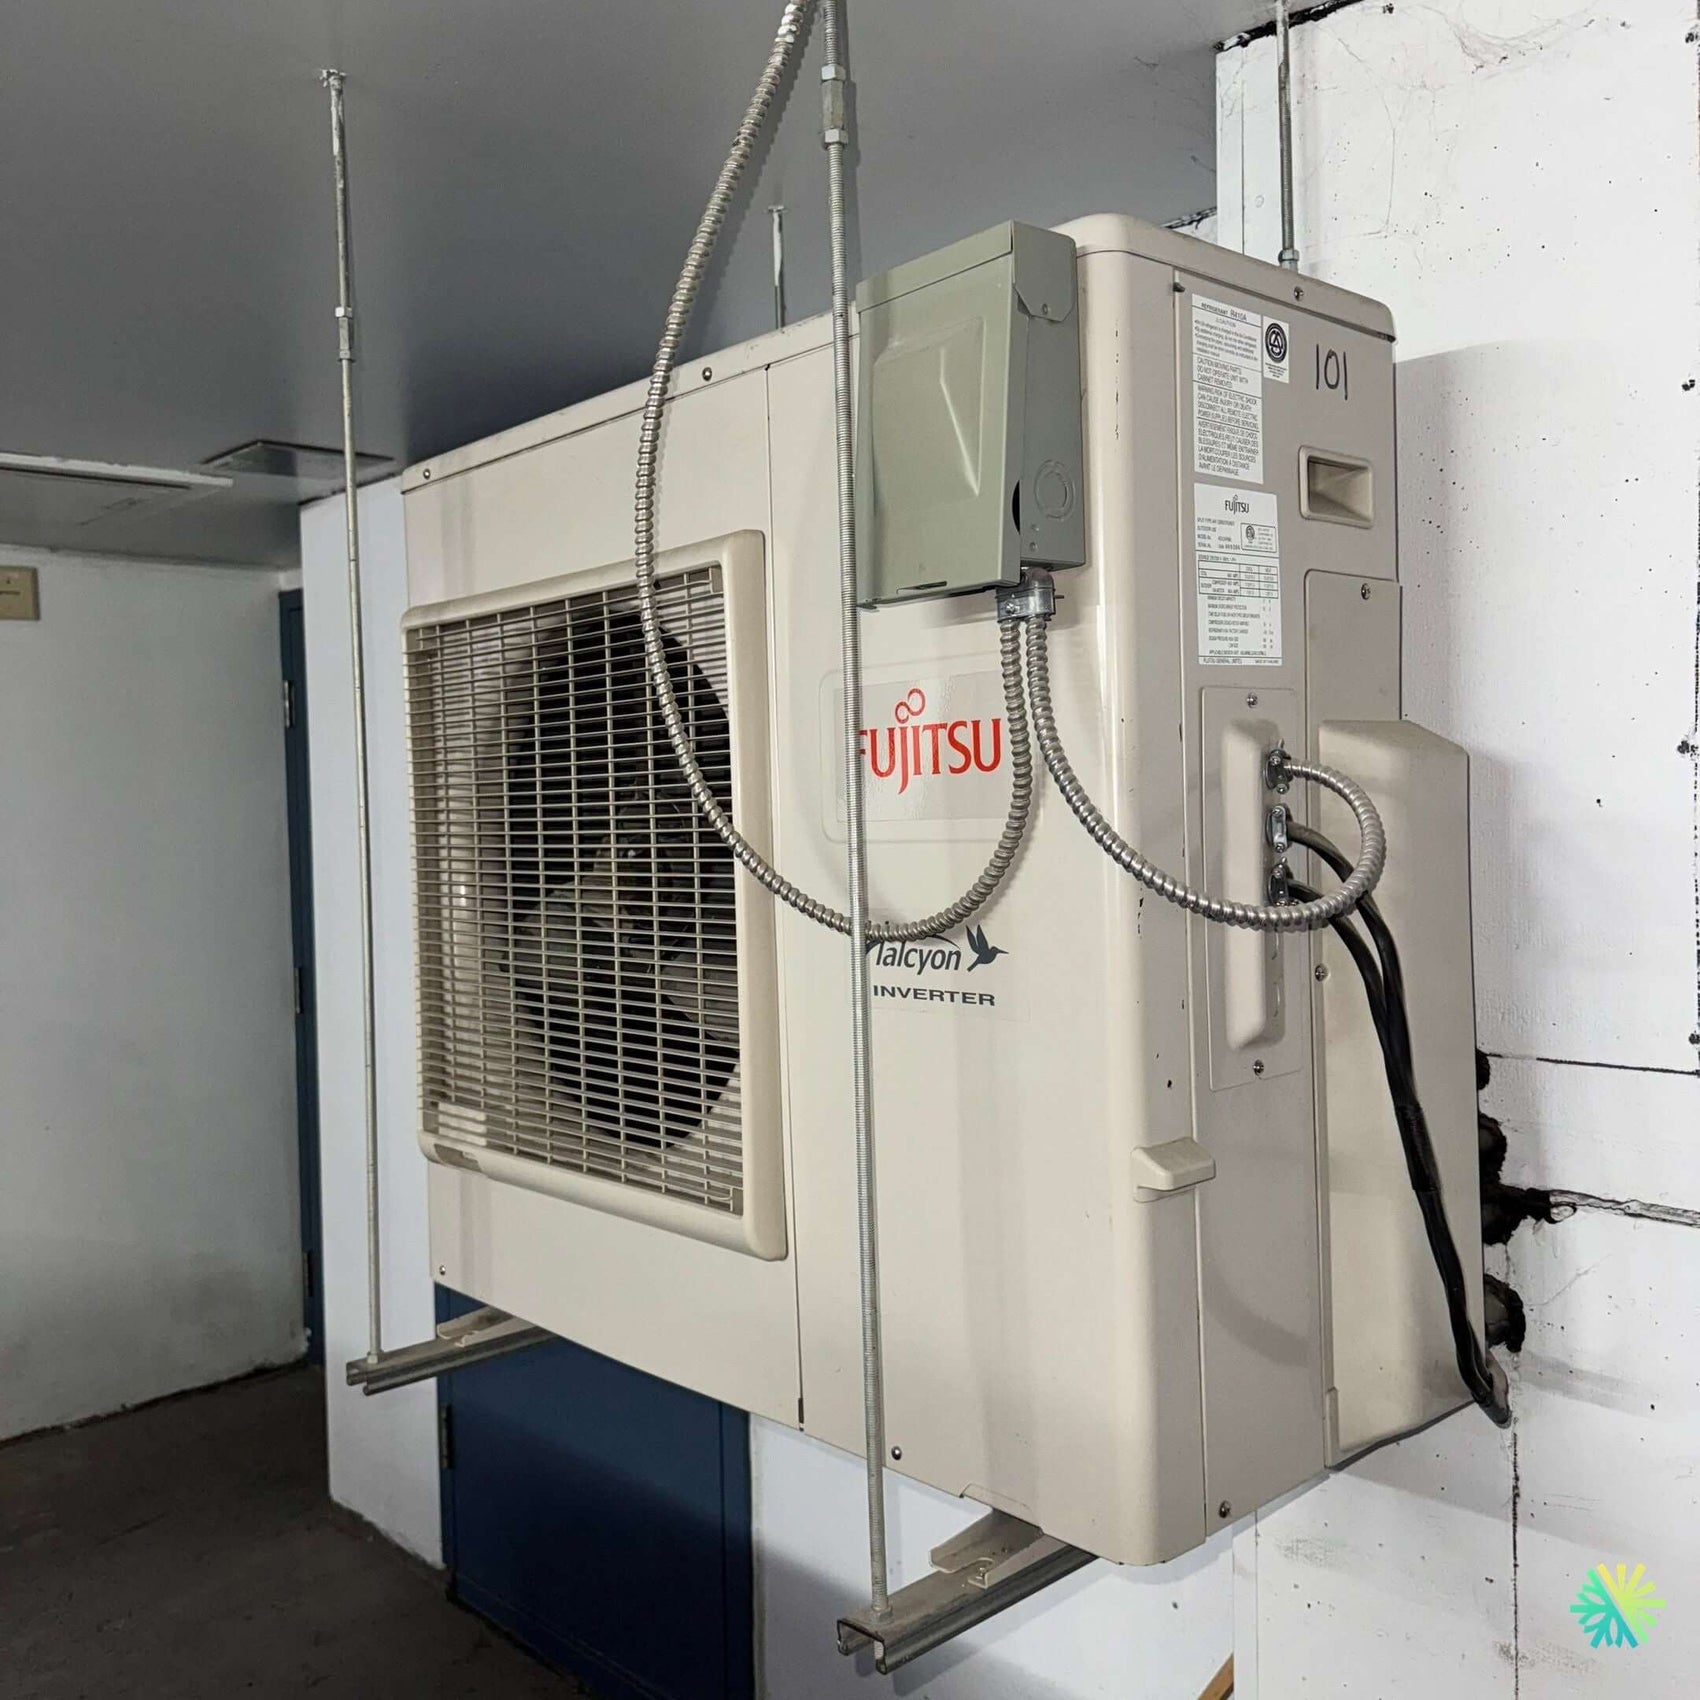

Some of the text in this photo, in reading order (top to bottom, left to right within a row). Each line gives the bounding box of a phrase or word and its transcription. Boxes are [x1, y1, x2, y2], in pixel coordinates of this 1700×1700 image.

[1316, 343, 1348, 401] 101
[1224, 499, 1249, 514] FUJITSU
[873, 984, 996, 1006] INVERTER
